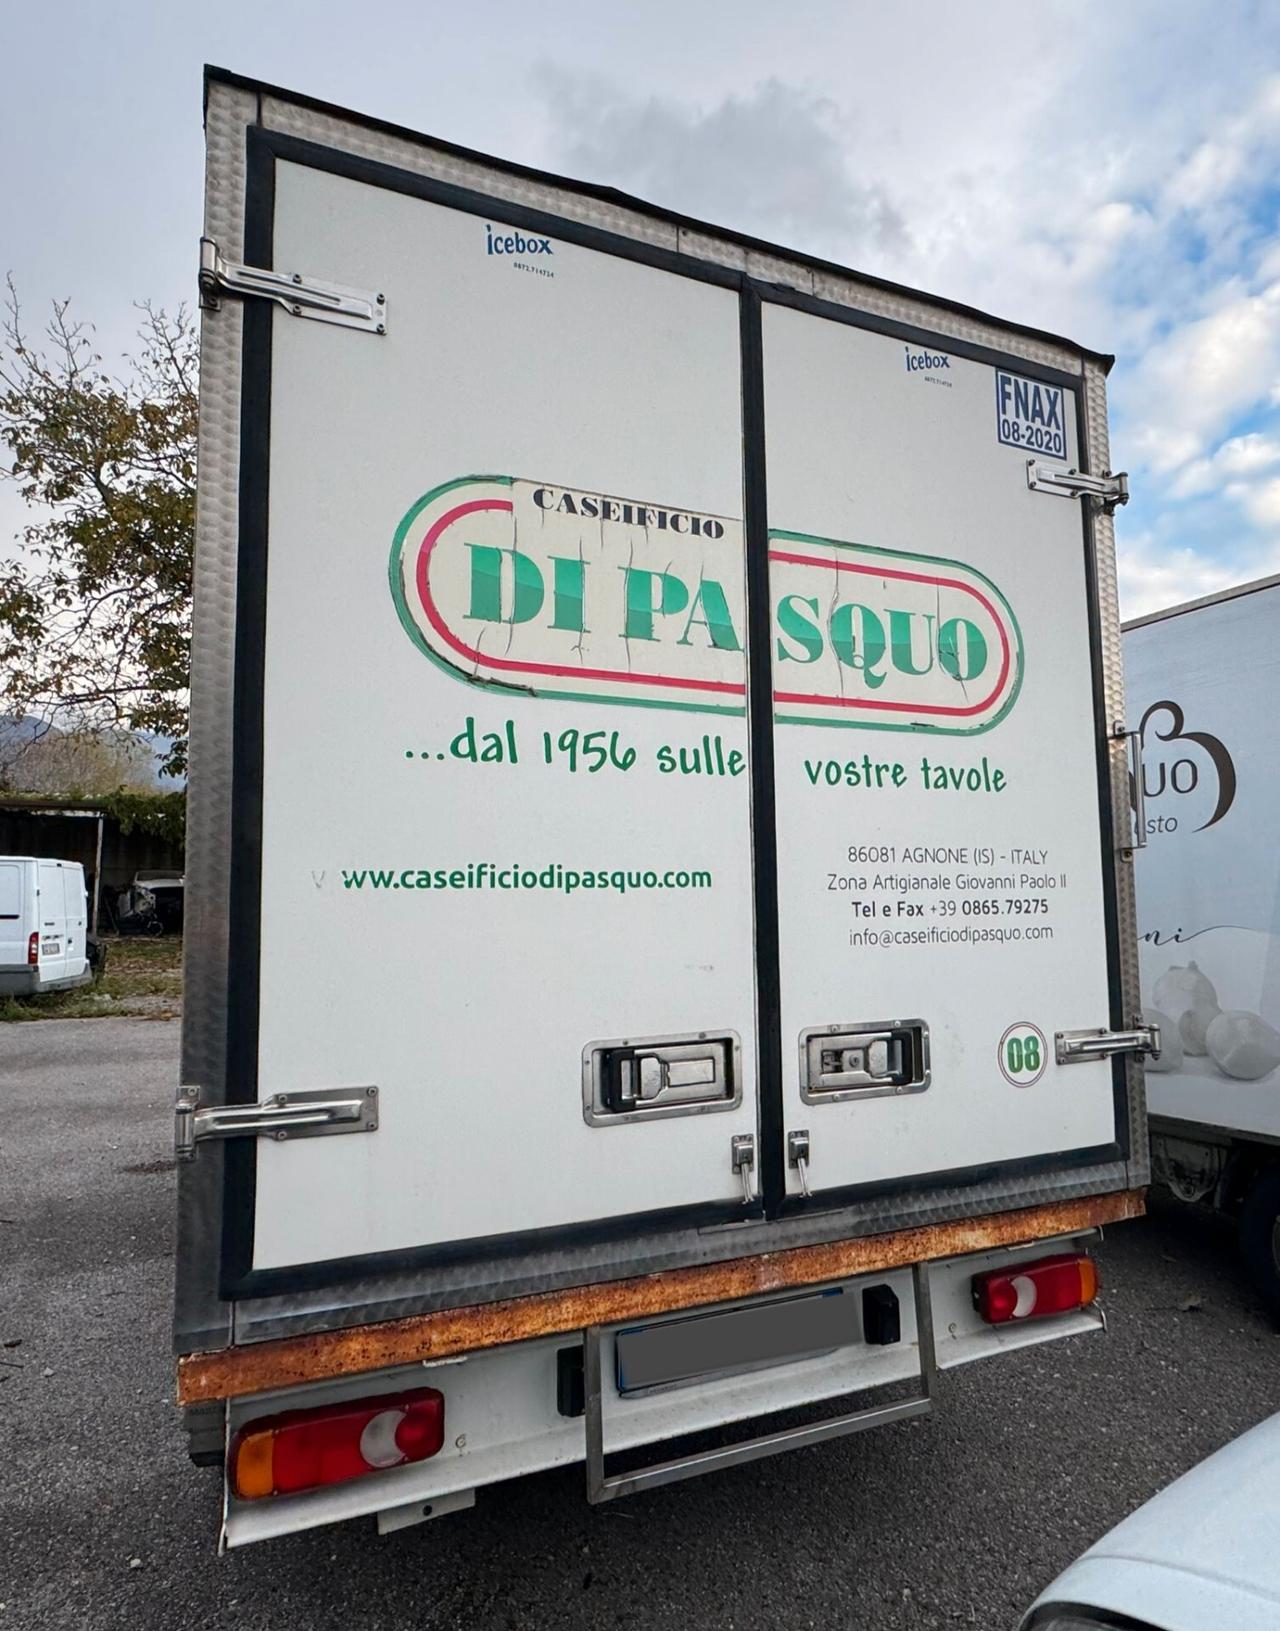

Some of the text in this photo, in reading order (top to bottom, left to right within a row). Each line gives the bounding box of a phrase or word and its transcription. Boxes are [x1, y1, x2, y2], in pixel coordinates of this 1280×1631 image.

[485, 224, 554, 255] icebox
[904, 346, 950, 372] icebox
[1000, 374, 1061, 430] FNAX
[1001, 418, 1062, 454] 08-2020
[533, 488, 725, 540] CASEIFICIO
[462, 542, 591, 634] DI
[542, 728, 637, 774] 1956
[655, 735, 746, 777] sulle
[803, 754, 908, 788] vostre
[921, 756, 1008, 793] tavole
[847, 846, 896, 863] 86081
[902, 848, 969, 865] AGNONE
[973, 847, 996, 866] (IS)
[1010, 848, 1049, 866] ITALY
[826, 873, 868, 891] Zona
[872, 873, 952, 894] Artigianale
[955, 873, 1016, 890] Giovanni
[1019, 874, 1057, 889] Paolo
[851, 898, 1049, 918] Tel e Fax +39 0865.79275
[849, 925, 1055, 949] info@caseificiodipasquo.com
[1006, 1036, 1040, 1074] 08
